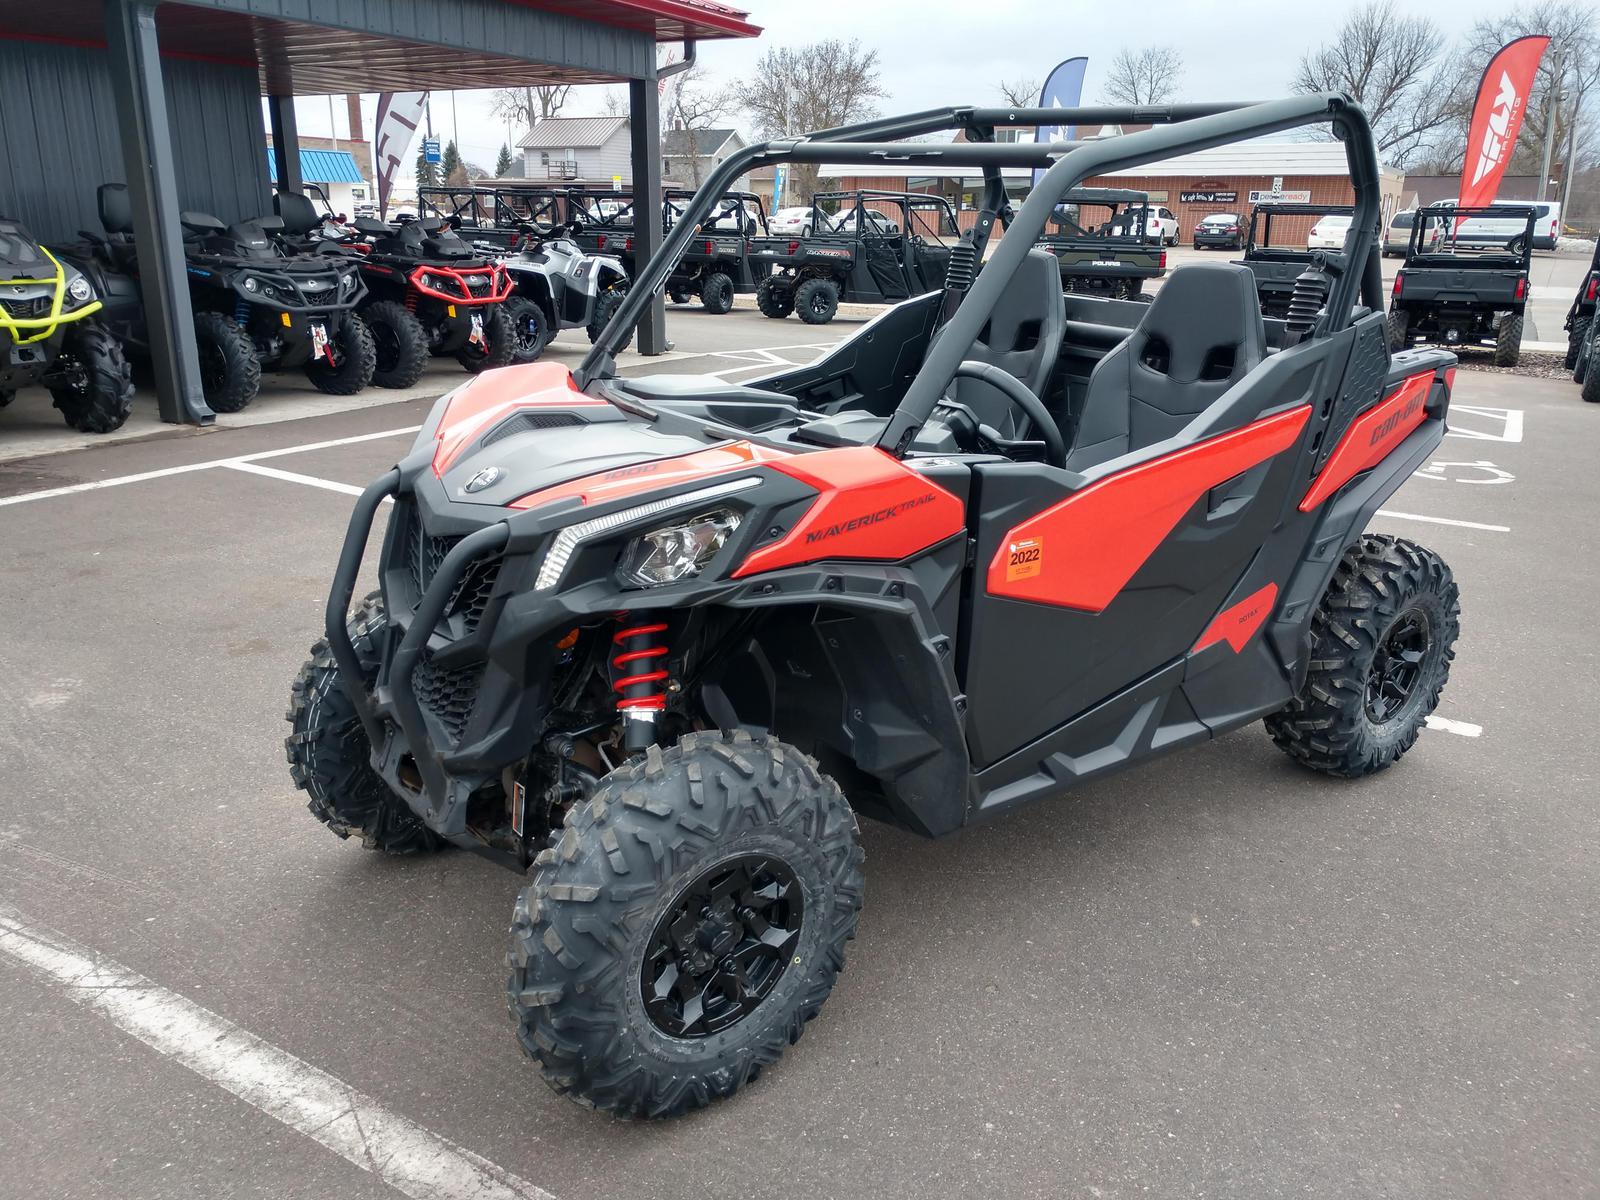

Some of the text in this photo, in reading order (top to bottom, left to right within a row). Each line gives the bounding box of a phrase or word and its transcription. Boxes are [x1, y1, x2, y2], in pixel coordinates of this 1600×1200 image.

[1481, 70, 1516, 165] FLY
[1497, 97, 1522, 164] RACING
[805, 493, 936, 545] MAVERICK TRAIL
[1010, 548, 1040, 566] 2022
